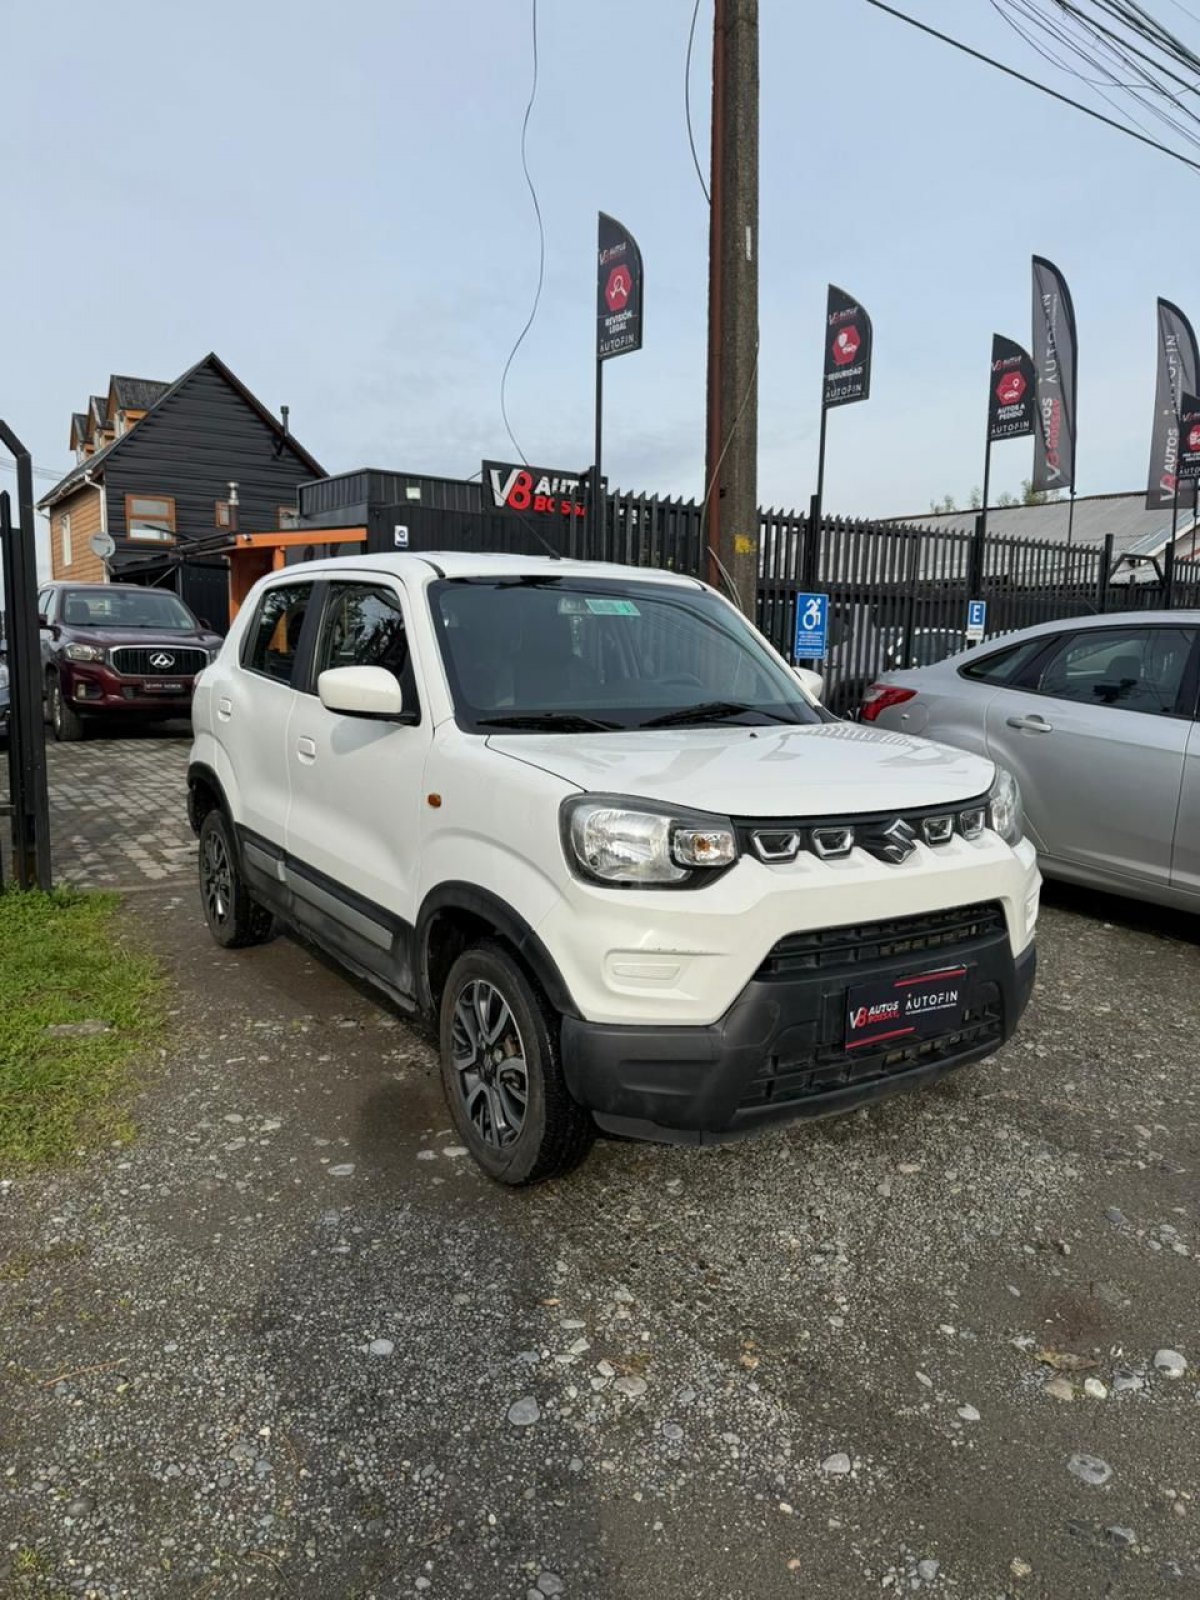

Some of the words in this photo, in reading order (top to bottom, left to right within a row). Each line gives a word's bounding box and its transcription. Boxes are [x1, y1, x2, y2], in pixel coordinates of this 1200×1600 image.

[1164, 428, 1179, 474] AUTOS
[489, 468, 533, 510] V8
[534, 476, 604, 496] AUT
[973, 604, 981, 622] E
[869, 1000, 899, 1017] AUTOS
